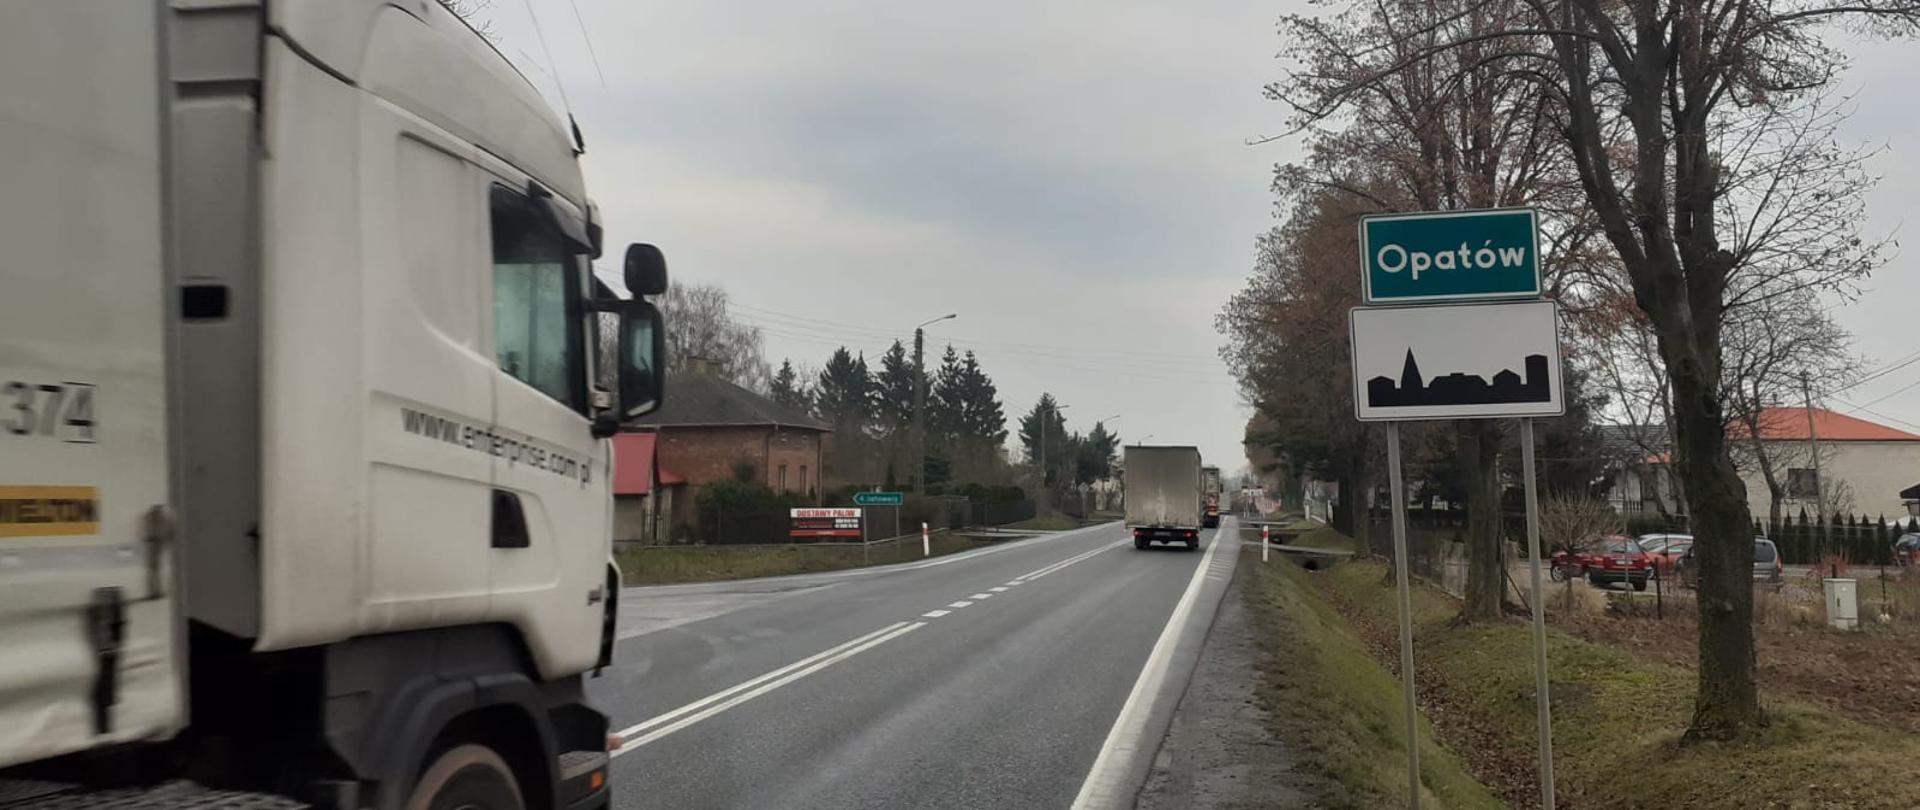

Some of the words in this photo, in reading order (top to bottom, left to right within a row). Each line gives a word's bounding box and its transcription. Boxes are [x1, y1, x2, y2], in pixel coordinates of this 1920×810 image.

[1377, 239, 1525, 281] Opatów
[797, 509, 831, 518] DOSTAWY
[833, 509, 856, 518] PALIW
